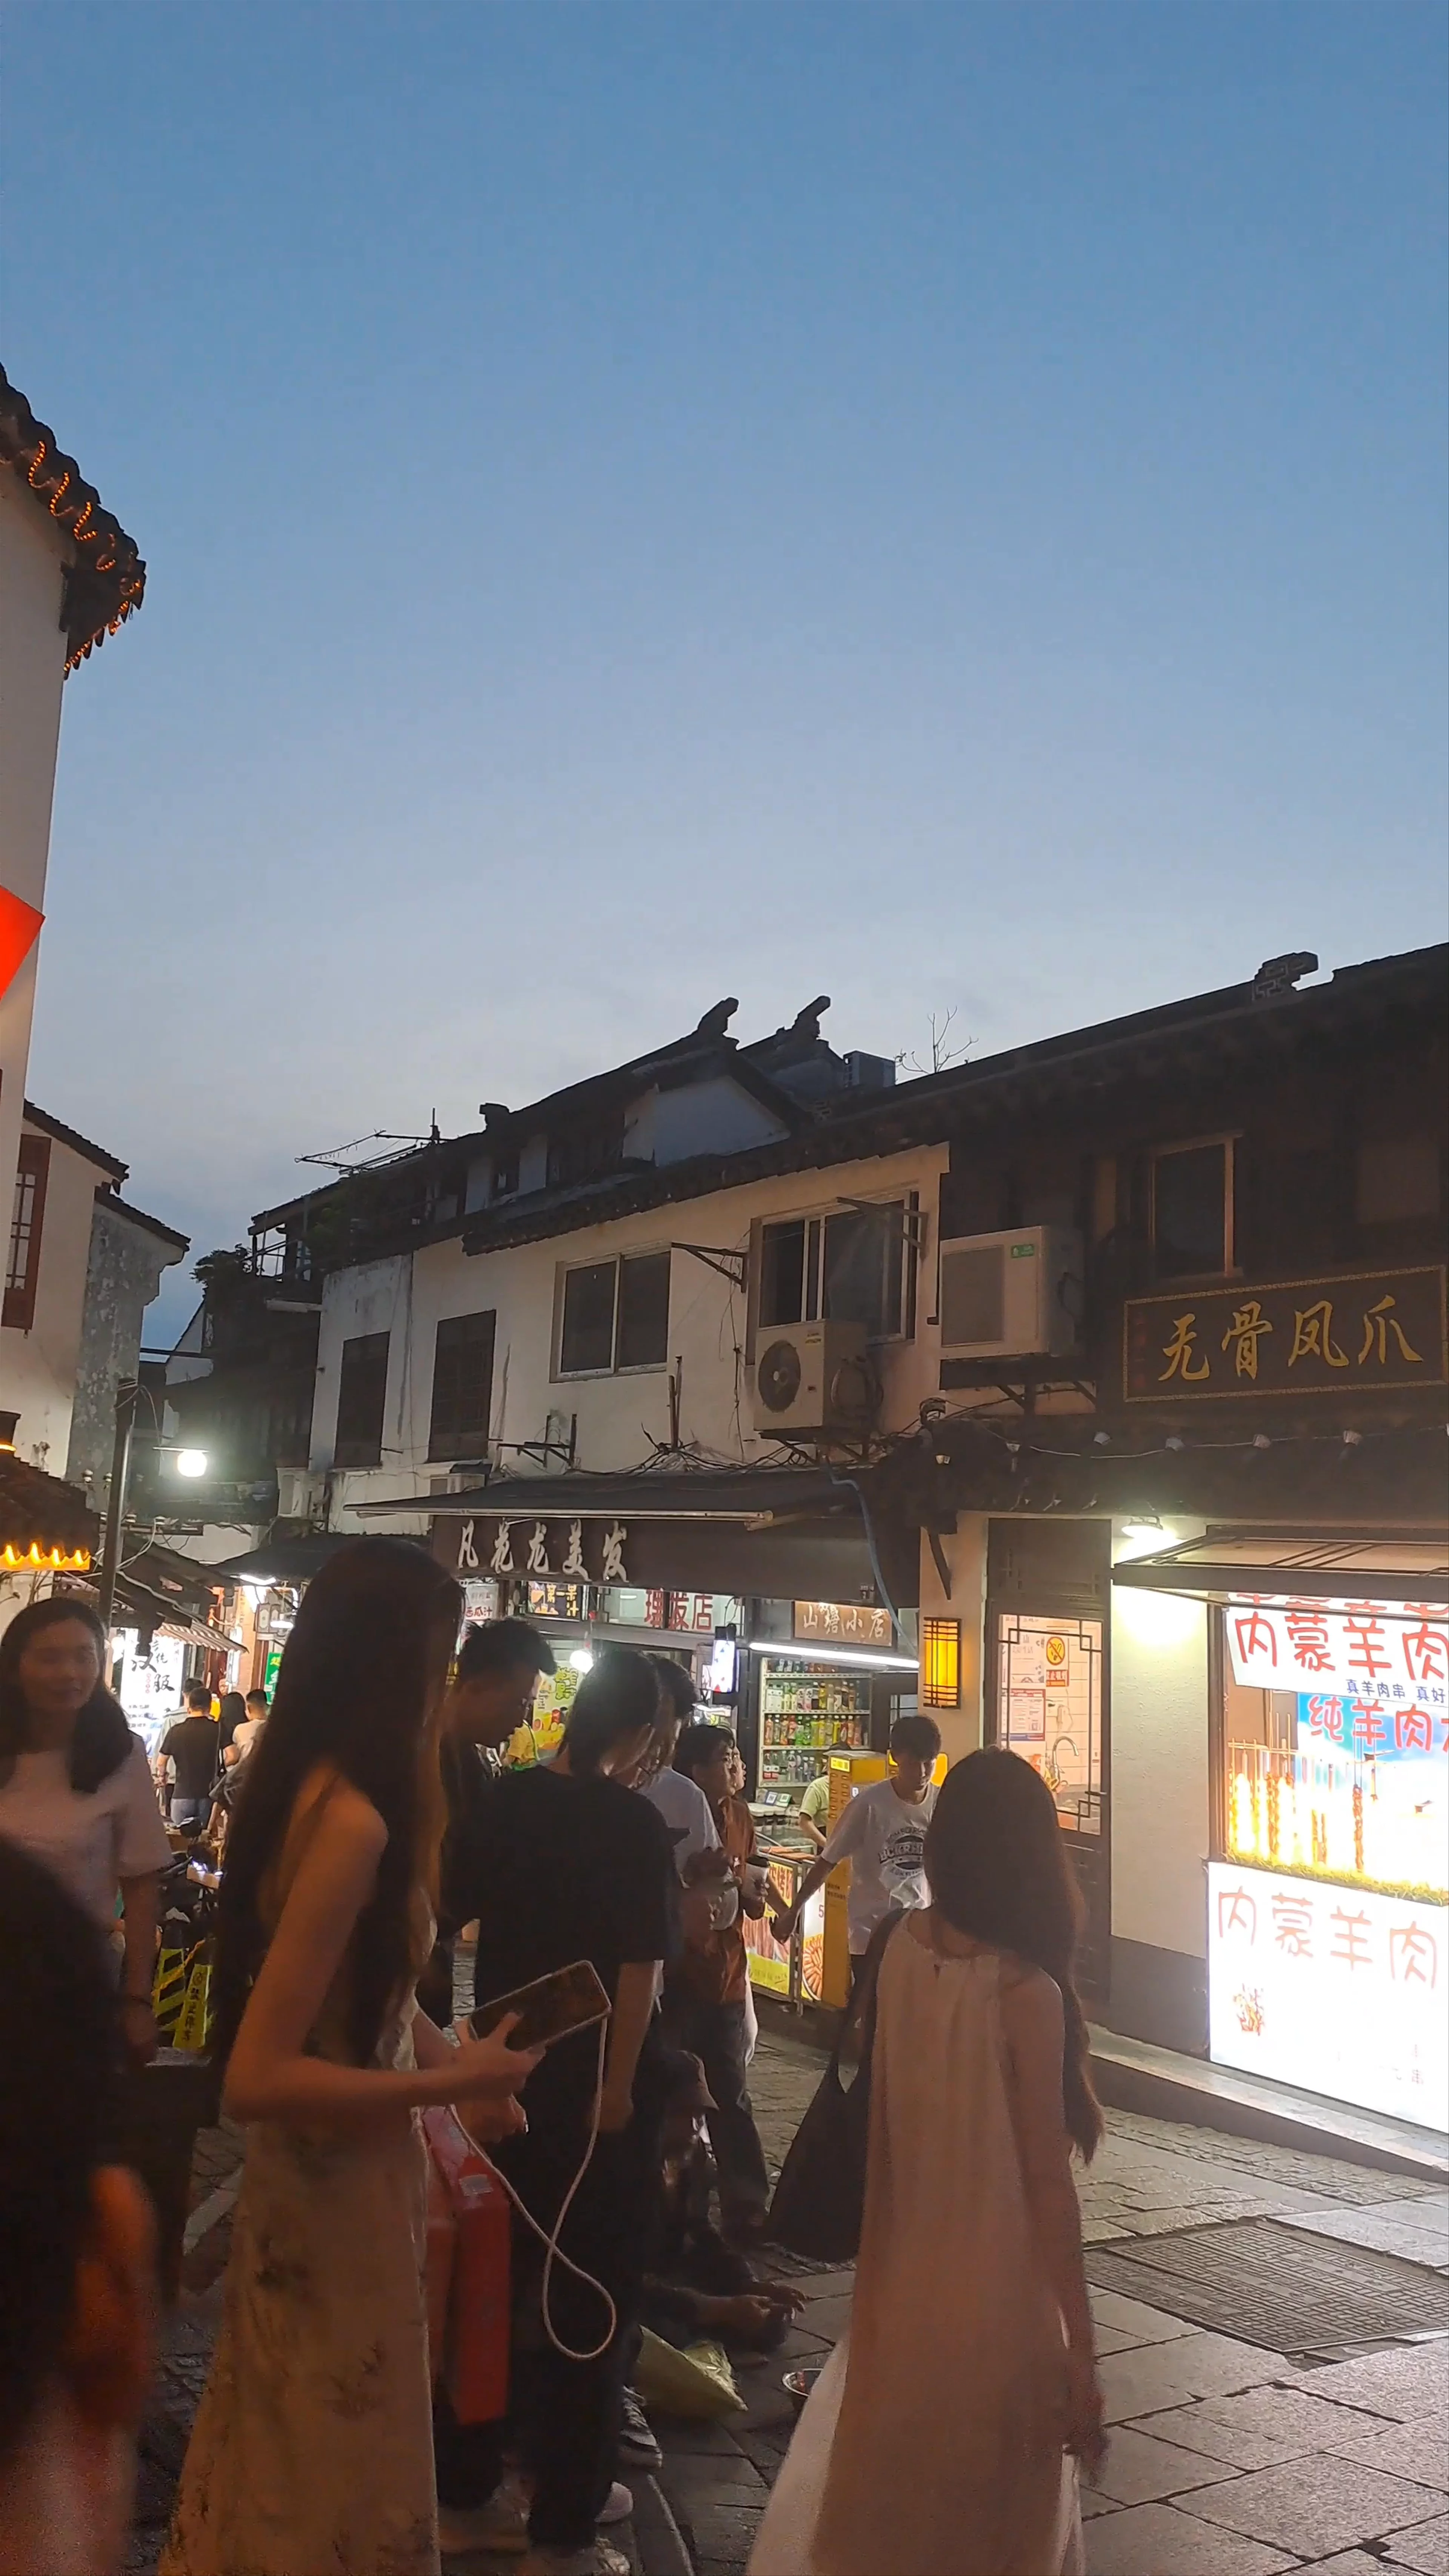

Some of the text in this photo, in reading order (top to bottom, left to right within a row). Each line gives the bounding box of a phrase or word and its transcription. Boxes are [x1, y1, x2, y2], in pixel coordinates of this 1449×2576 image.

[1158, 1295, 1423, 1381] 无骨凤爪
[1235, 1611, 1449, 1681] 内蒙羊肉
[1309, 1696, 1449, 1752] 纯羊肉
[1346, 1679, 1446, 1703] 真羊肉串 真好
[1218, 1886, 1437, 1989] 内蒙羊肉
